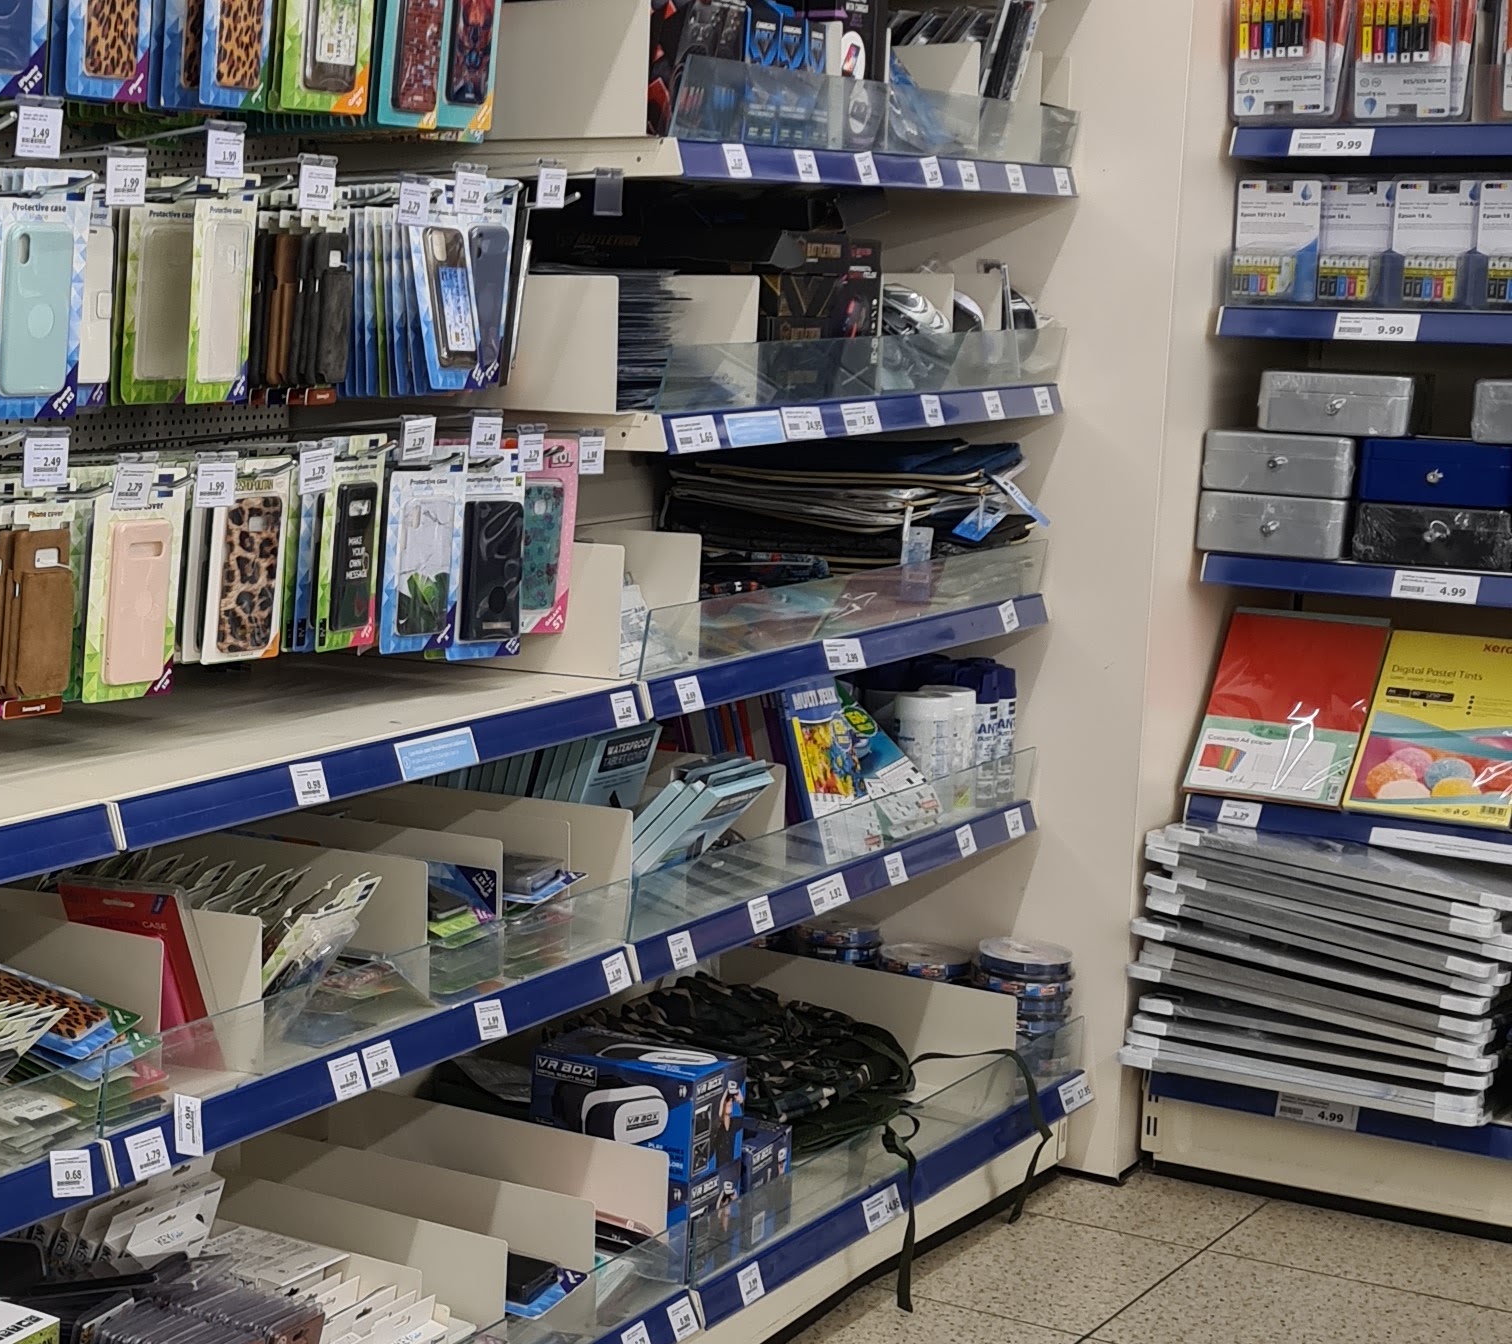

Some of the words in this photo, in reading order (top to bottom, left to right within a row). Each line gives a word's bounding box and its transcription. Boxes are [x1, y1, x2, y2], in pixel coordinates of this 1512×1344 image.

[32, 127, 50, 139] 1.49
[1336, 139, 1362, 150] 9.99
[123, 177, 140, 189] 1.99
[12, 201, 49, 213] Protective
[50, 204, 66, 213] case
[1377, 325, 1404, 335] 9.99
[44, 456, 61, 467] 2.49
[209, 481, 225, 492] 1.99
[28, 509, 47, 519] Phone
[48, 510, 64, 518] cover
[1439, 586, 1467, 598] 4.99
[1391, 663, 1423, 678] Digital
[1424, 665, 1455, 679] Pastel
[1459, 668, 1483, 682] Tints
[1208, 732, 1240, 743] Coloured
[1251, 738, 1272, 747] paper
[606, 736, 653, 757] WATERPROOF
[142, 921, 168, 930] CASE
[538, 1057, 559, 1071] VR
[561, 1059, 594, 1077] BOX
[1317, 1110, 1344, 1123] 4.99
[145, 1148, 161, 1161] 1.79
[65, 1168, 82, 1181] 0.68
